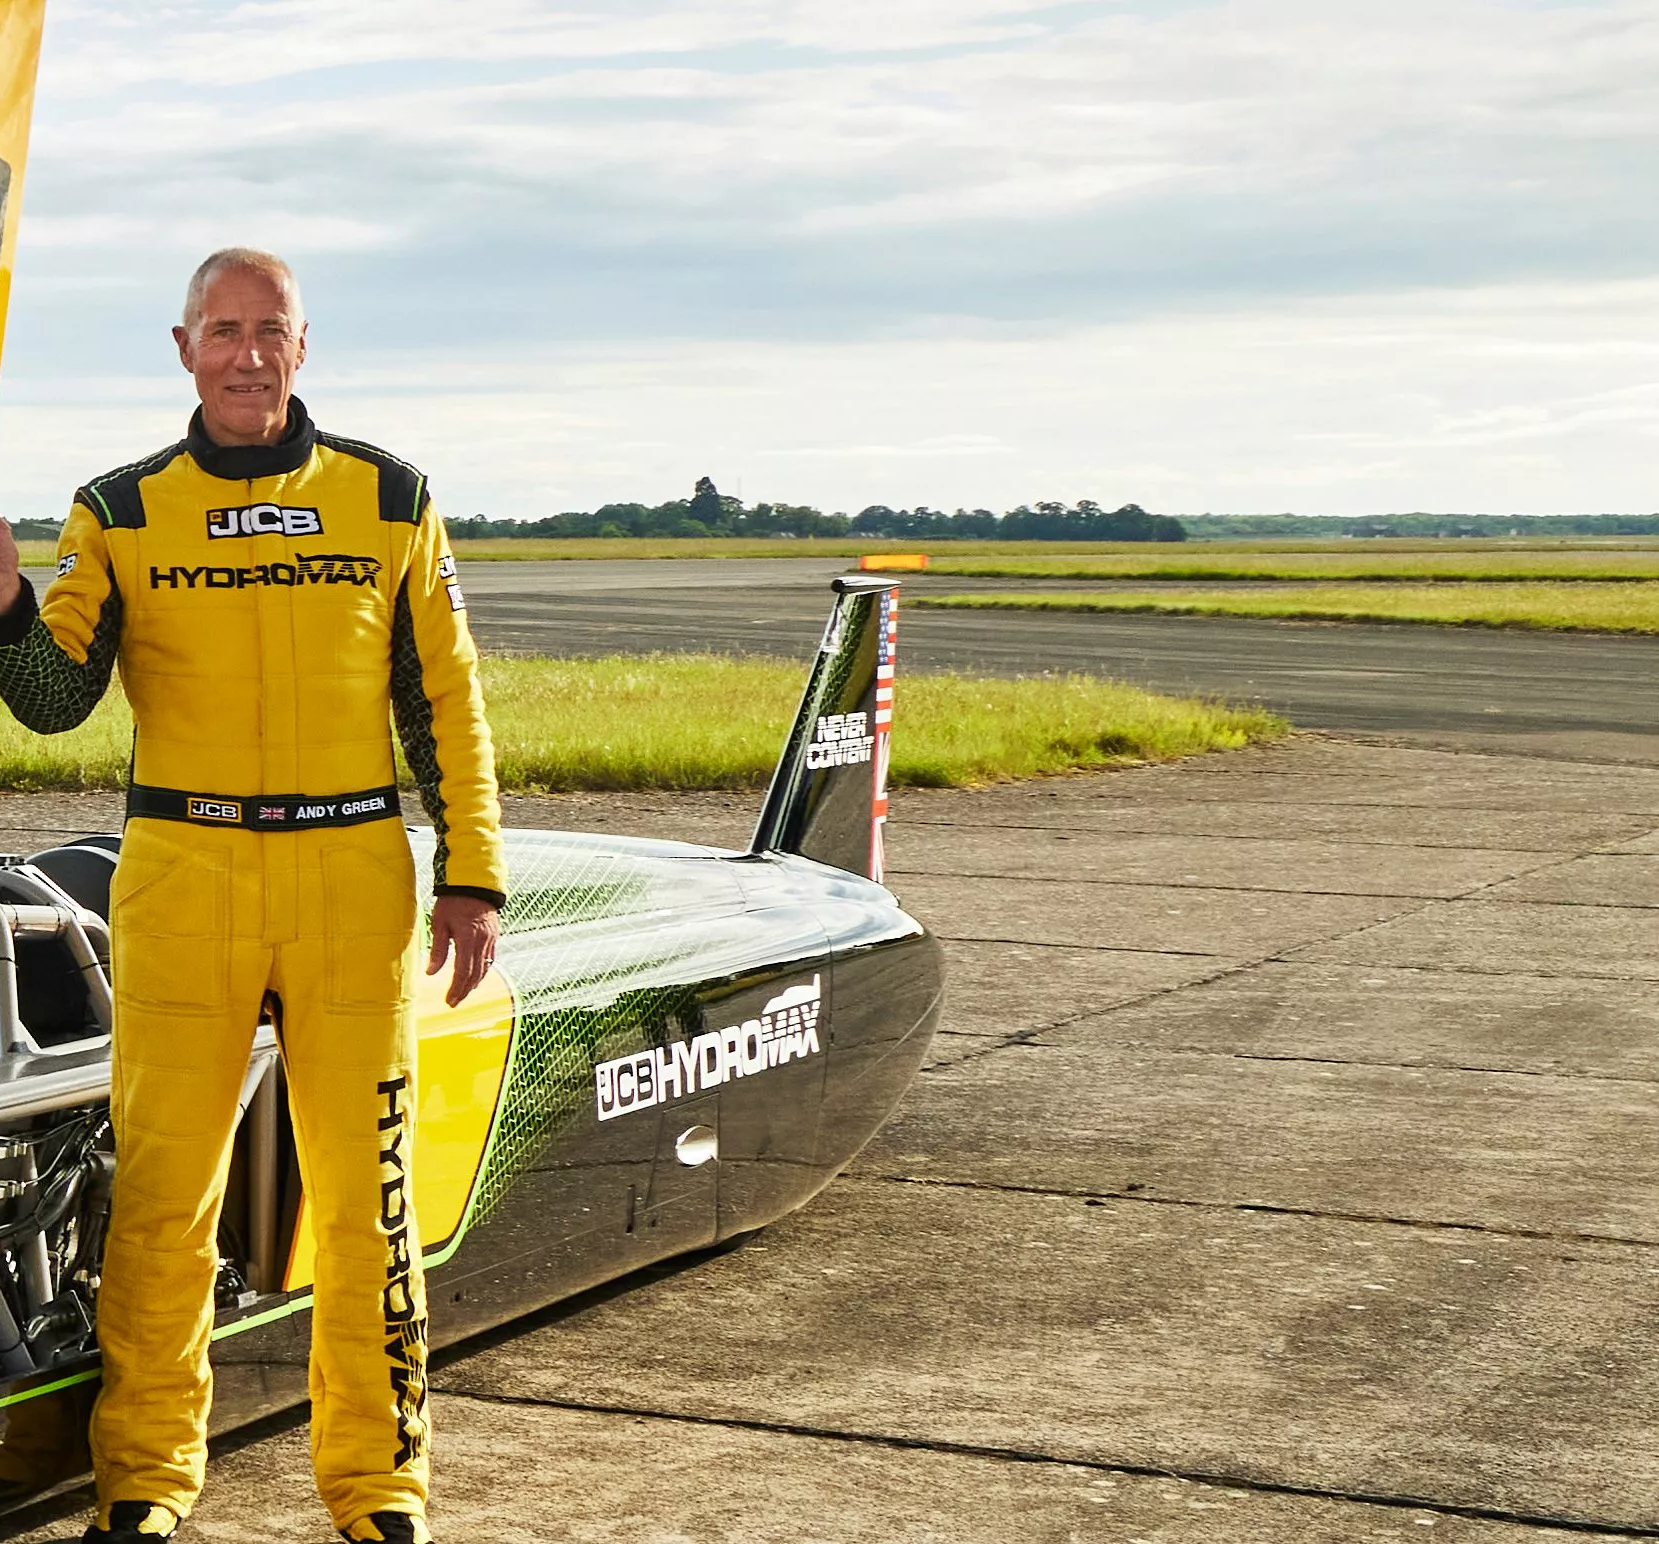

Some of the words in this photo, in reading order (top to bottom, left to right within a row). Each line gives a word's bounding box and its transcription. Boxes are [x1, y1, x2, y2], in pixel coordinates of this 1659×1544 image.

[209, 505, 320, 537] JCB
[57, 556, 77, 576] CB
[149, 560, 383, 589] HYDROMAX
[817, 711, 867, 743] NEVER
[806, 735, 875, 770] CONTENT
[192, 802, 238, 818] JCB
[295, 804, 337, 820] ANDY
[341, 796, 386, 816] GREEN
[598, 1054, 655, 1114] JCB
[655, 1000, 821, 1104] HYDROMAX
